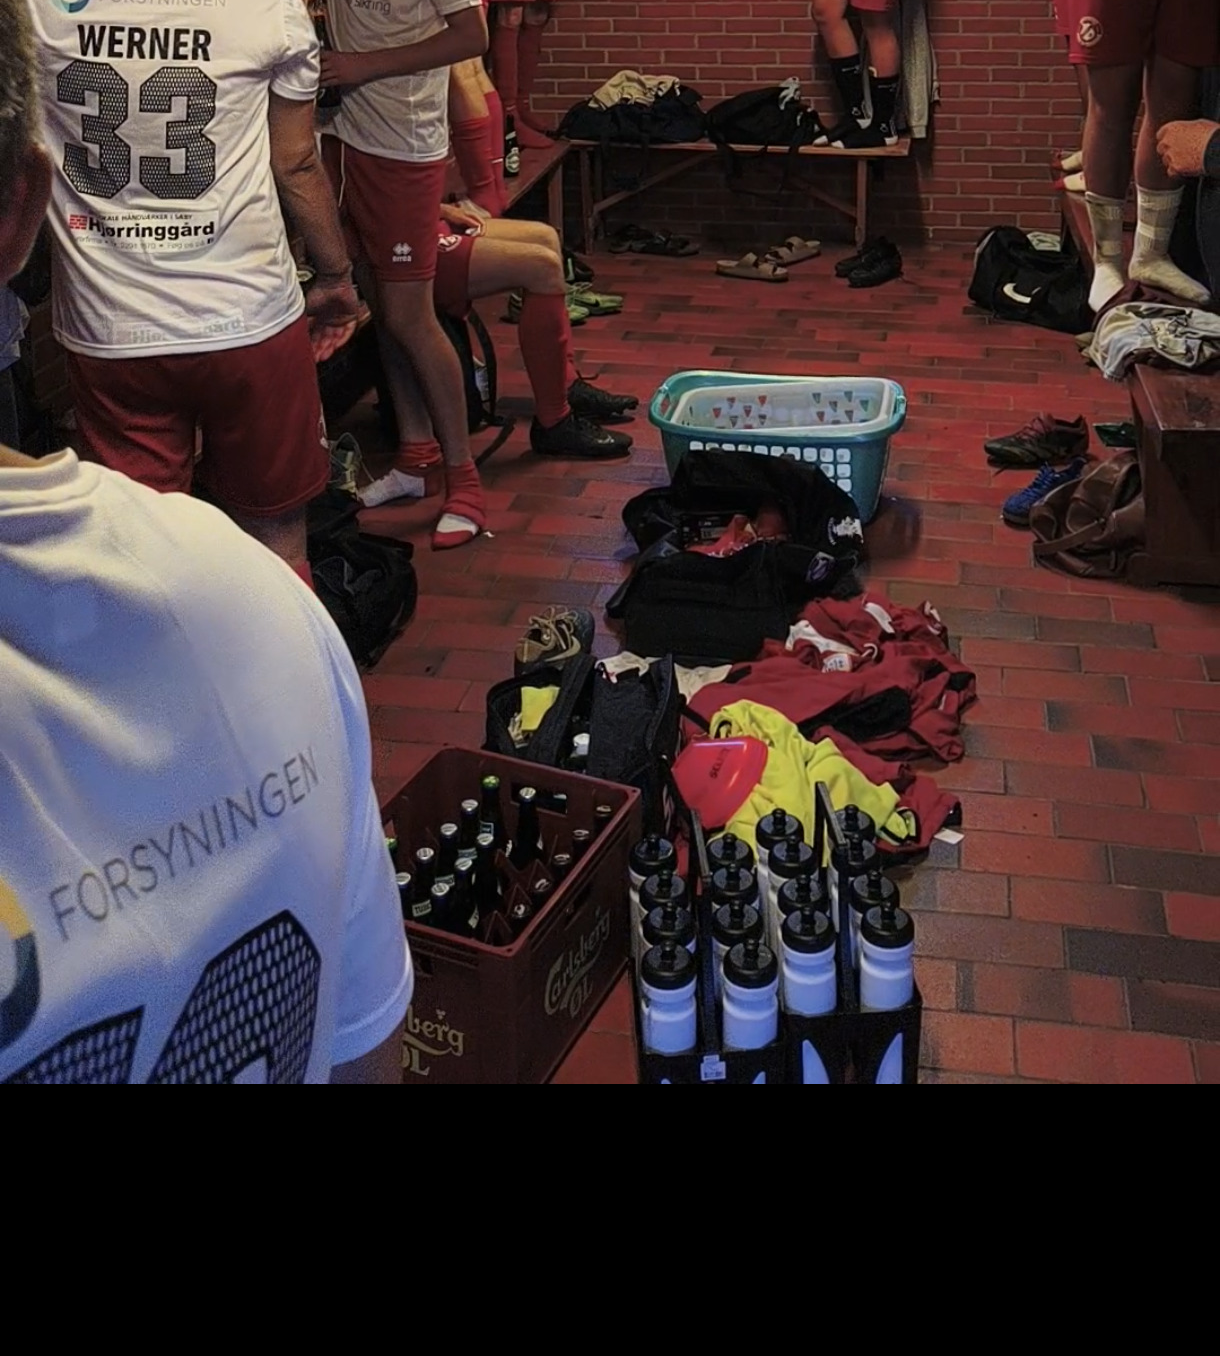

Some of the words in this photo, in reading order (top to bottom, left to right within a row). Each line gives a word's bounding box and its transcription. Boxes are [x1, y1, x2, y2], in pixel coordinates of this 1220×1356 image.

[77, 24, 211, 61] WERNER
[57, 59, 217, 200] 33
[88, 217, 215, 241] Hjørringgård
[49, 746, 319, 942] FORSYNINGEN
[544, 908, 610, 1015] Carlsberg
